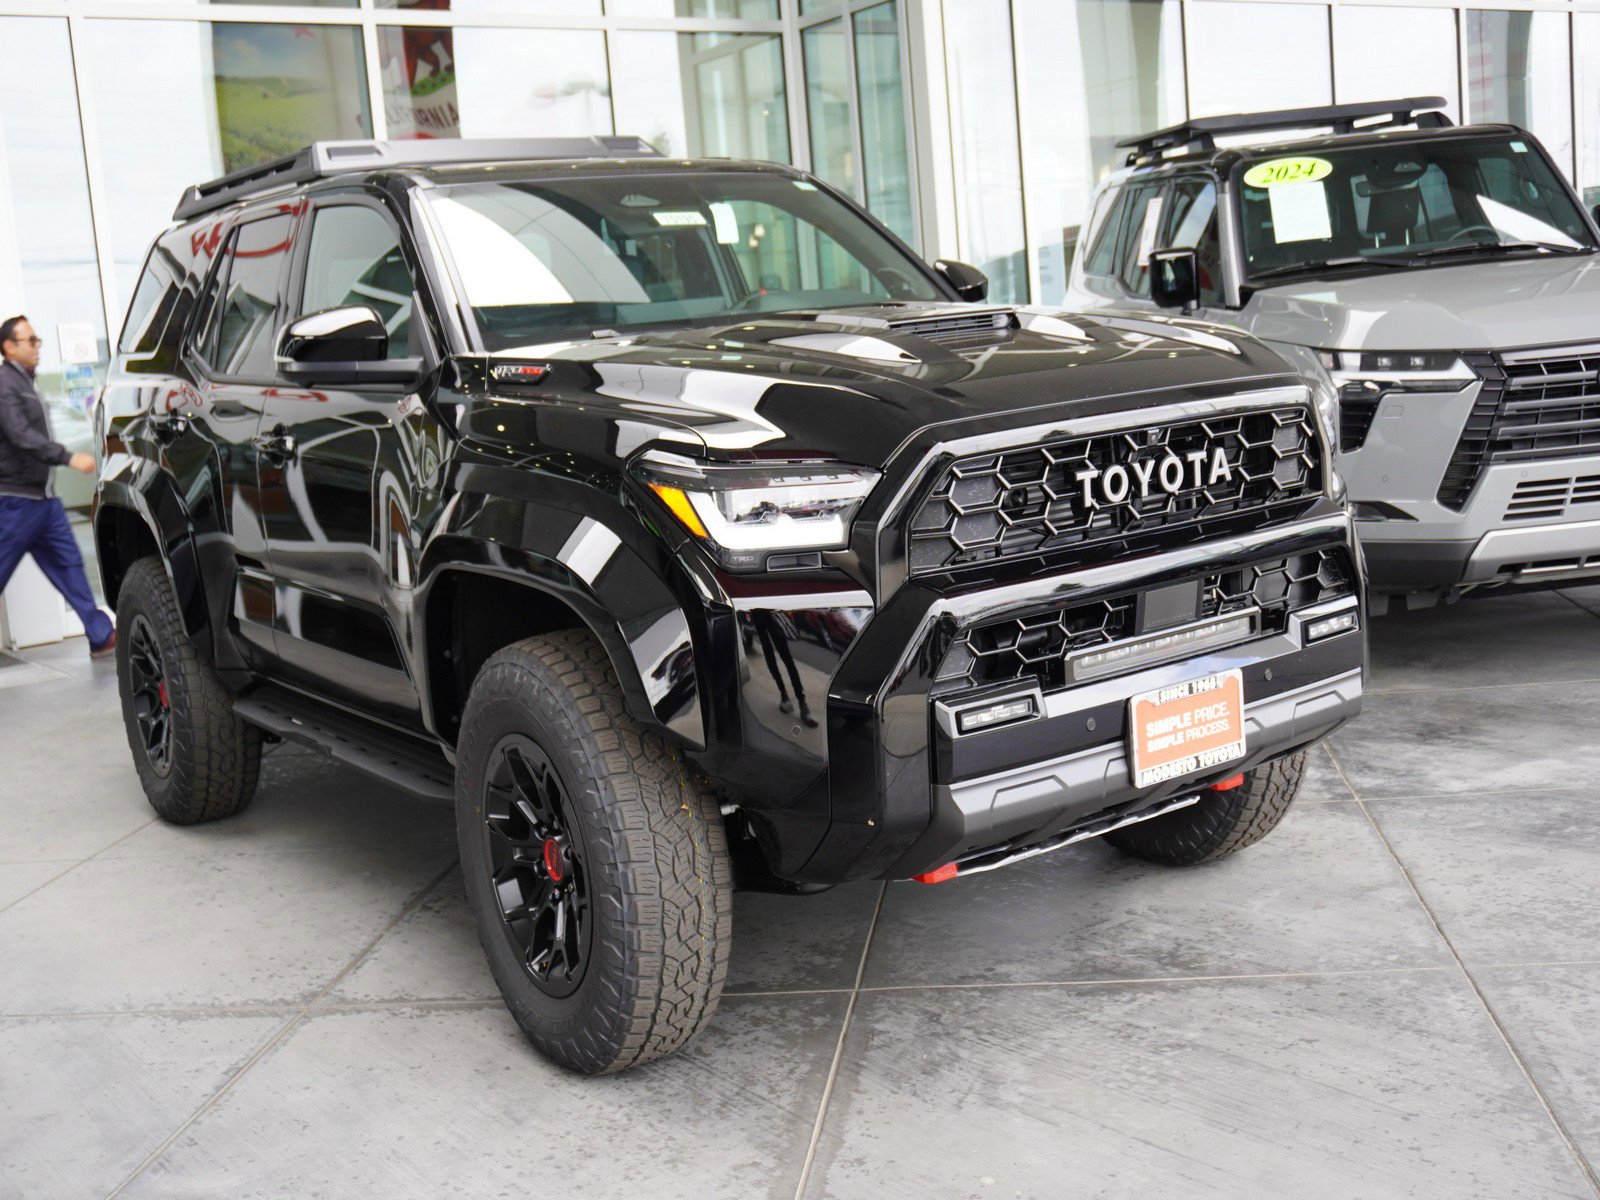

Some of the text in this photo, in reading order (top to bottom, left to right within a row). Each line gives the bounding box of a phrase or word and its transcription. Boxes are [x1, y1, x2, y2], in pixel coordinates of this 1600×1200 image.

[1262, 162, 1316, 183] 2024
[1075, 447, 1232, 508] TOYOTA
[1160, 684, 1190, 703] SINCE
[1146, 701, 1230, 738] SIMPLE PRICE.
[1147, 719, 1232, 753] SIMPLE PROCESS.
[1143, 743, 1241, 785] MODESTO TOYOTA
